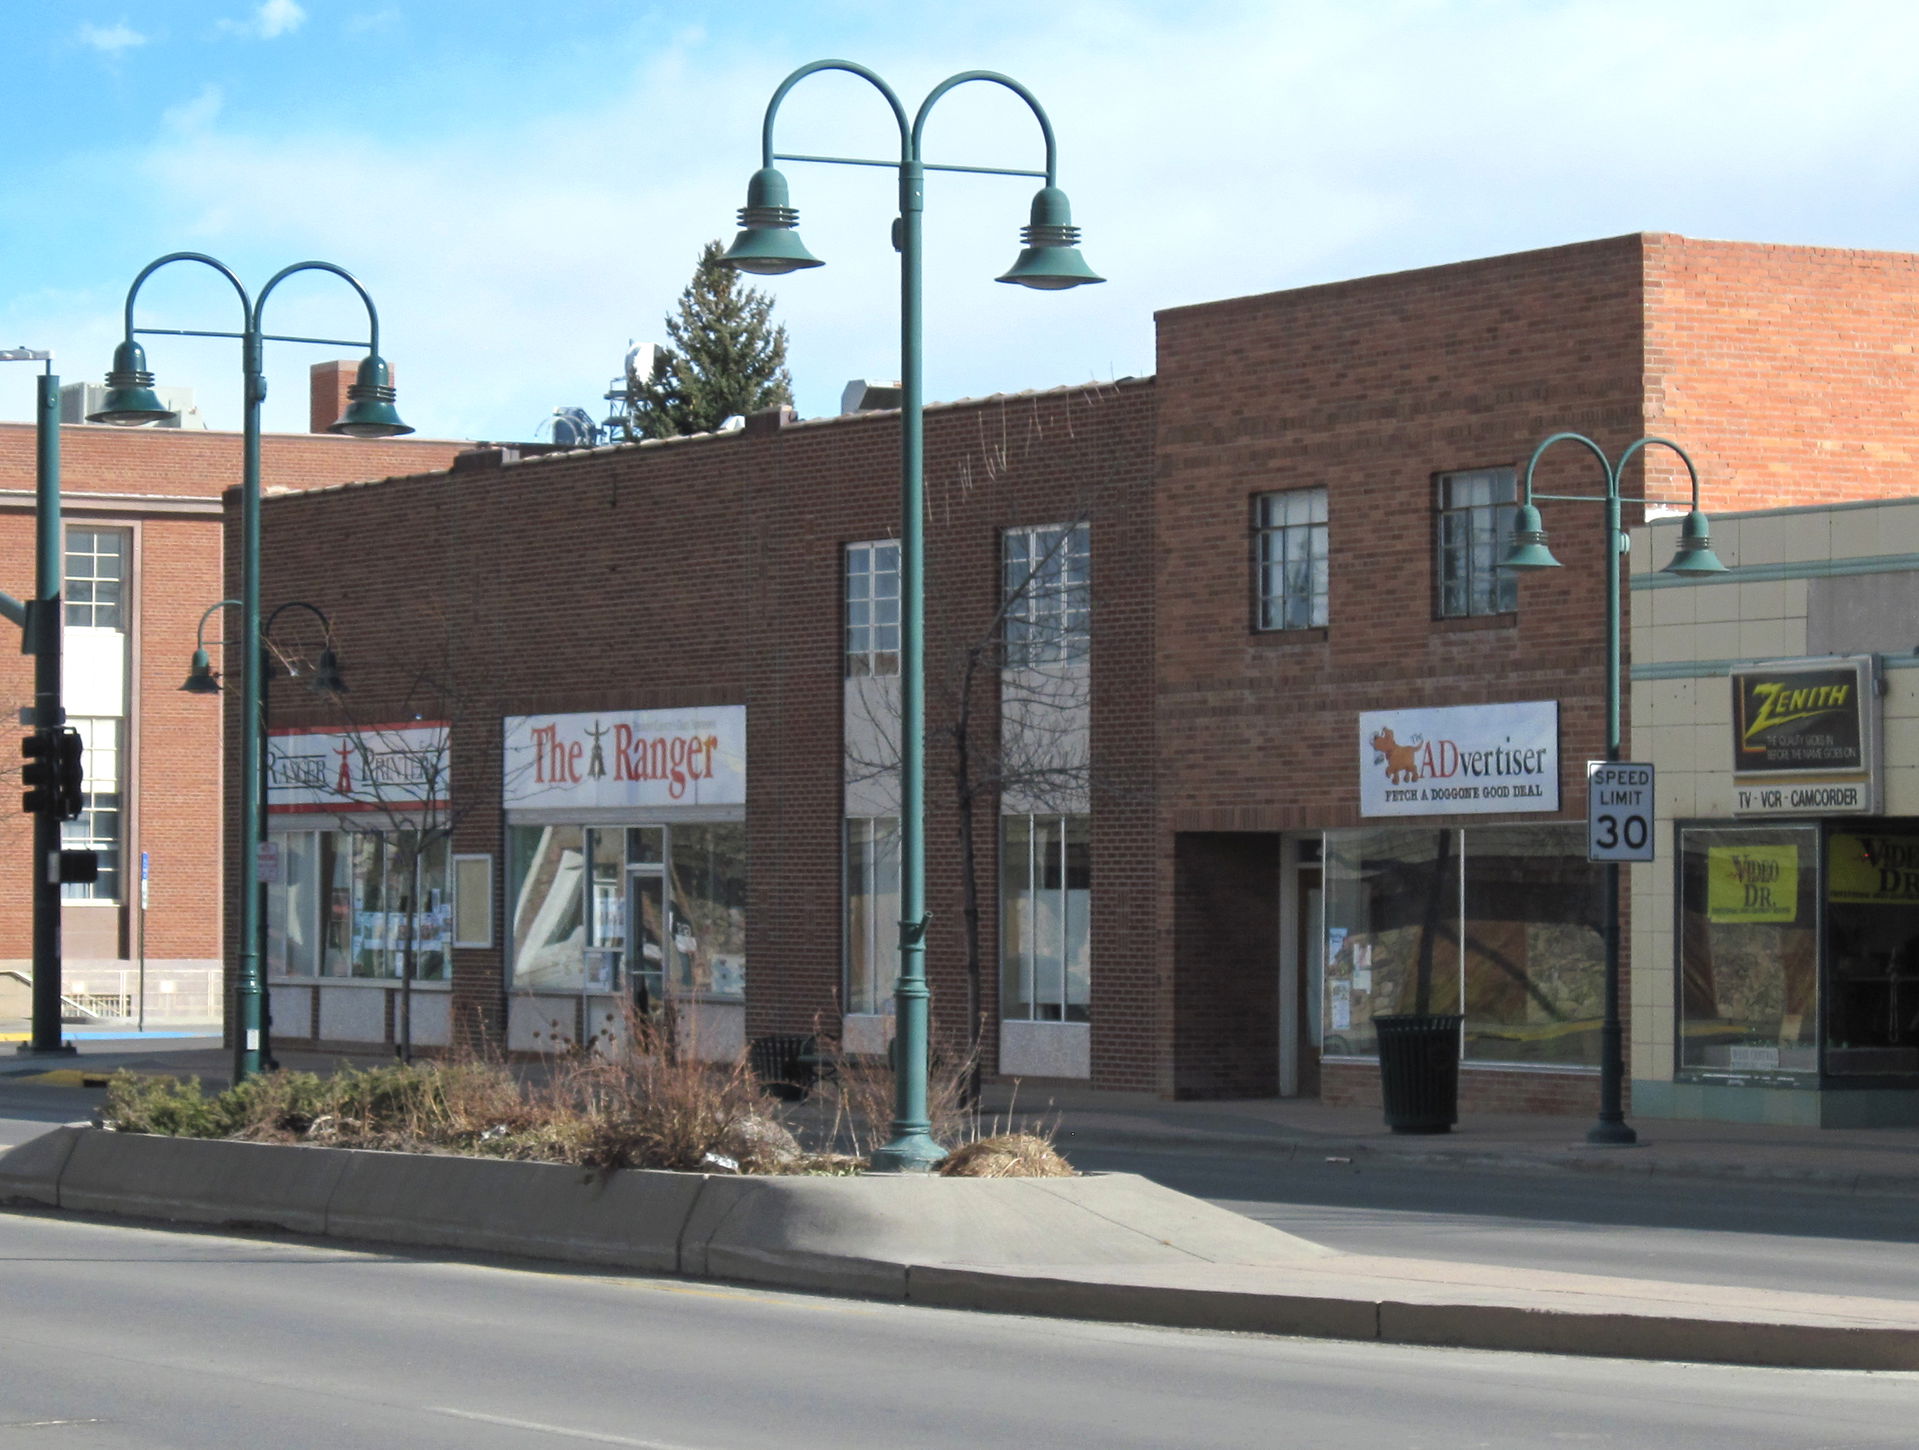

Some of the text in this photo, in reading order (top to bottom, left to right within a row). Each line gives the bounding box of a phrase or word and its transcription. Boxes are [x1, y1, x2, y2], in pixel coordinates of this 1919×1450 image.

[1743, 682, 1849, 740] ZENITH
[531, 722, 718, 799] The Ranger
[1419, 736, 1547, 779] ADvertiser
[1594, 770, 1650, 785] SPEED
[1385, 784, 1543, 802] FETCH A DOGGONE GOOD DEAL
[1600, 790, 1643, 805] LIMIT
[1738, 788, 1858, 809] TV VCR CAMCORDER
[1596, 814, 1648, 850] 30
[1730, 854, 1780, 883] VIDEO
